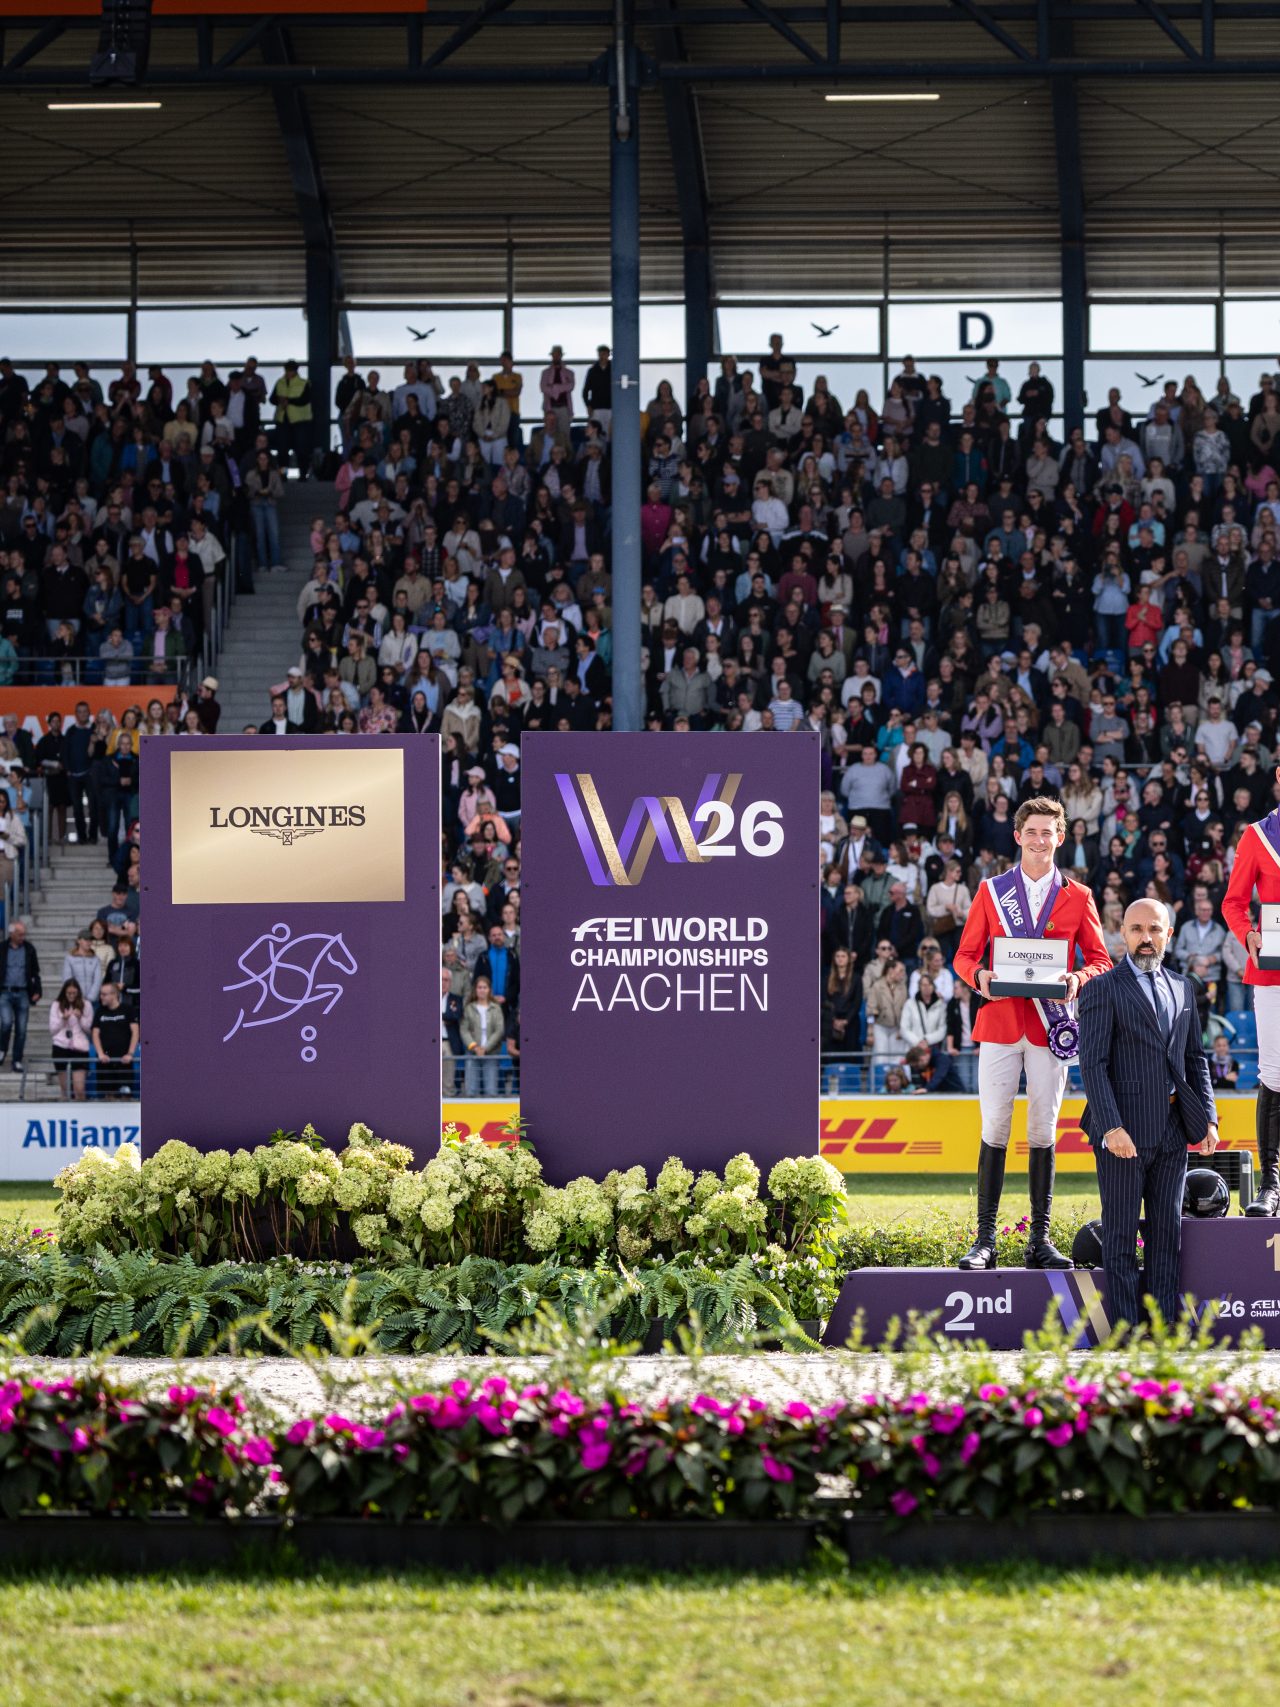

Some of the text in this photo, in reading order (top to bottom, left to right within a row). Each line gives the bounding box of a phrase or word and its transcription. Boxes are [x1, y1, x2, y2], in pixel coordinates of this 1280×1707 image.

[959, 311, 993, 351] D
[209, 805, 366, 828] LONGINES
[651, 917, 769, 942] WORLD
[570, 948, 769, 967] CHAMPIONSHIPS
[1008, 951, 1054, 960] LONGINES
[571, 973, 768, 1012] AACHEN
[23, 1120, 140, 1148] Allianz
[820, 1118, 908, 1154] HL
[944, 1289, 1012, 1331] 2nd
